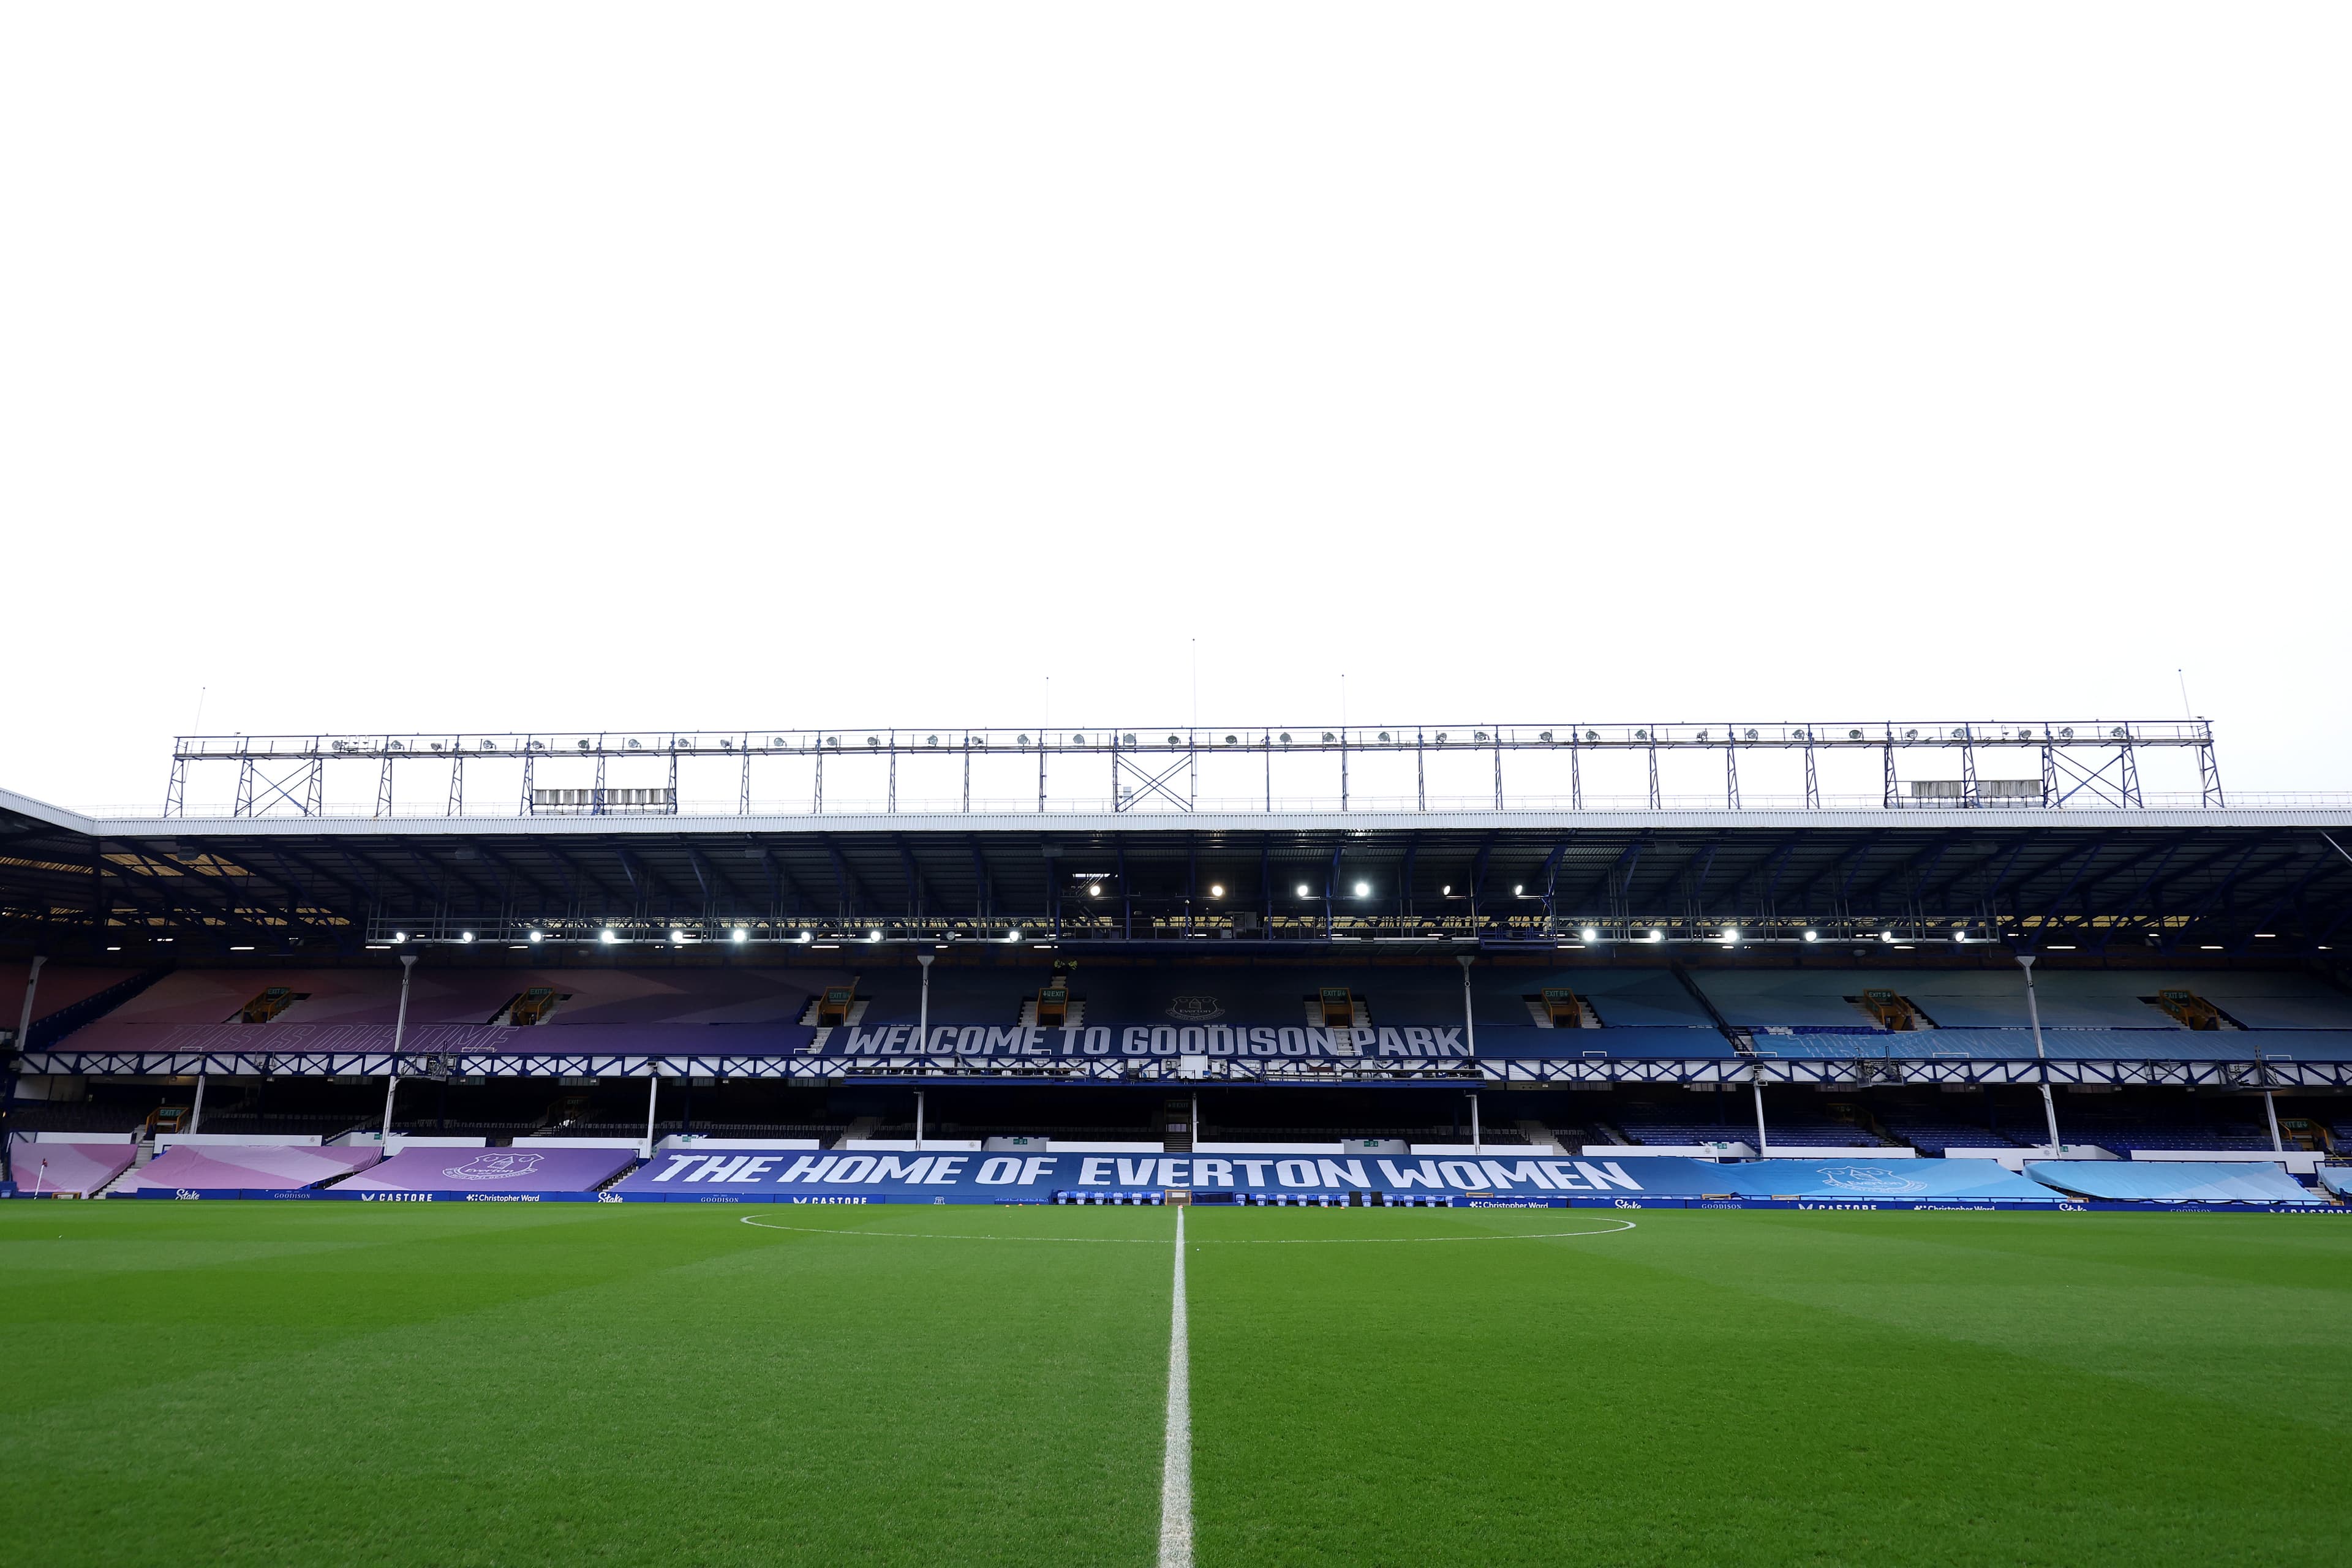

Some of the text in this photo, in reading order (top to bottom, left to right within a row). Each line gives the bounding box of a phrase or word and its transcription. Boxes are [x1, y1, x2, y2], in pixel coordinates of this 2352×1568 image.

[150, 1024, 519, 1053] THIS IS OUR TIME
[844, 1027, 1469, 1056] WELCOME TO GOODISON PARK
[652, 1155, 1644, 1190] THE HOME OF EVERTON WOMEN
[175, 1189, 200, 1200] Stake
[379, 1193, 432, 1202] CASTORE
[598, 1191, 623, 1203] Stake
